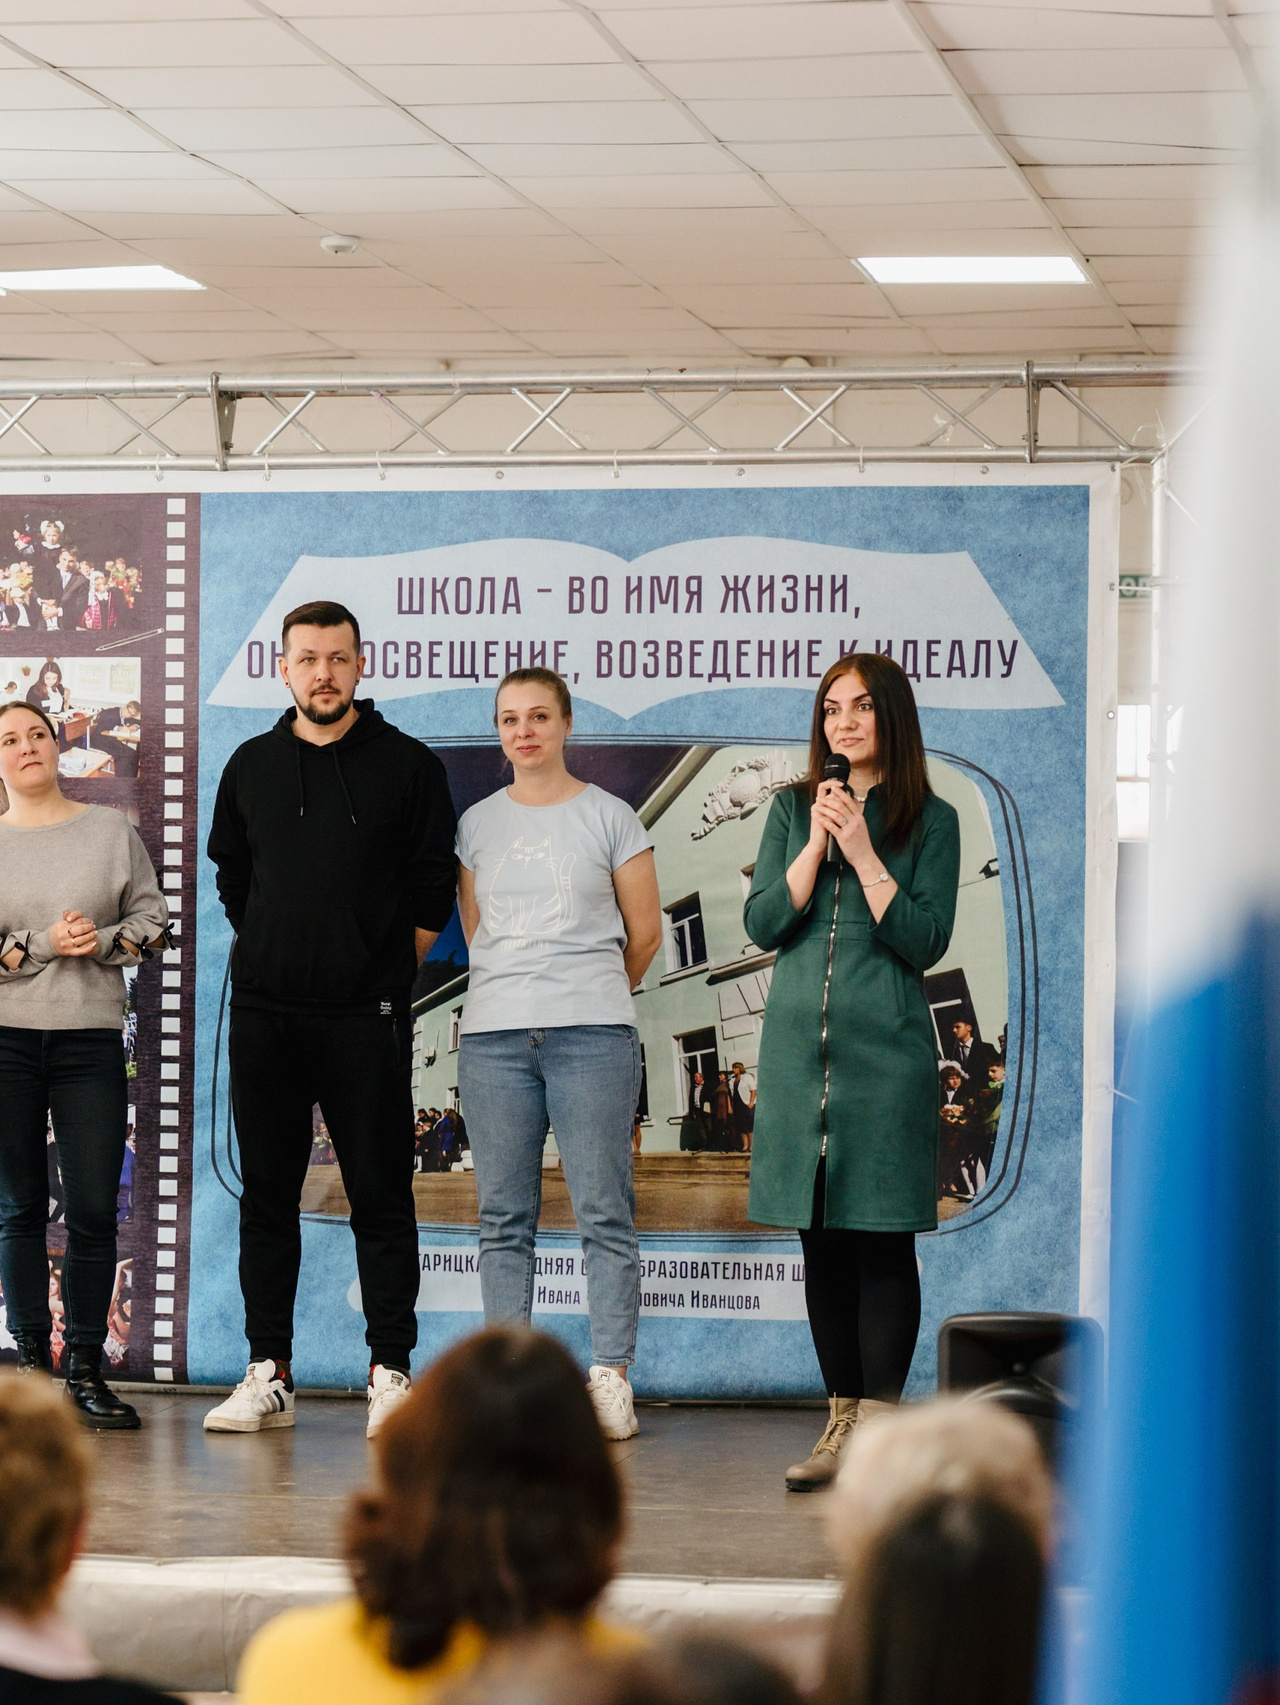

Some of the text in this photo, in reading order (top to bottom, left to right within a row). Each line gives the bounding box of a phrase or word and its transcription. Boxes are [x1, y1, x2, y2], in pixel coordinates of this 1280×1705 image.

[396, 576, 522, 615] ШКОЛА
[568, 575, 609, 615] ВО
[625, 575, 703, 614] ИМЯ
[720, 574, 861, 619] ЖИЗНИ,
[247, 640, 284, 679] ОН
[596, 640, 822, 683] ВОЗВЕДЕНИЕ
[418, 1253, 480, 1274] АРИЦК
[534, 1256, 574, 1277] ДНЯЯ
[581, 1258, 785, 1282] БРАЗОВАТЕЛЬНАЯ
[639, 1292, 685, 1308] ОВИЧА
